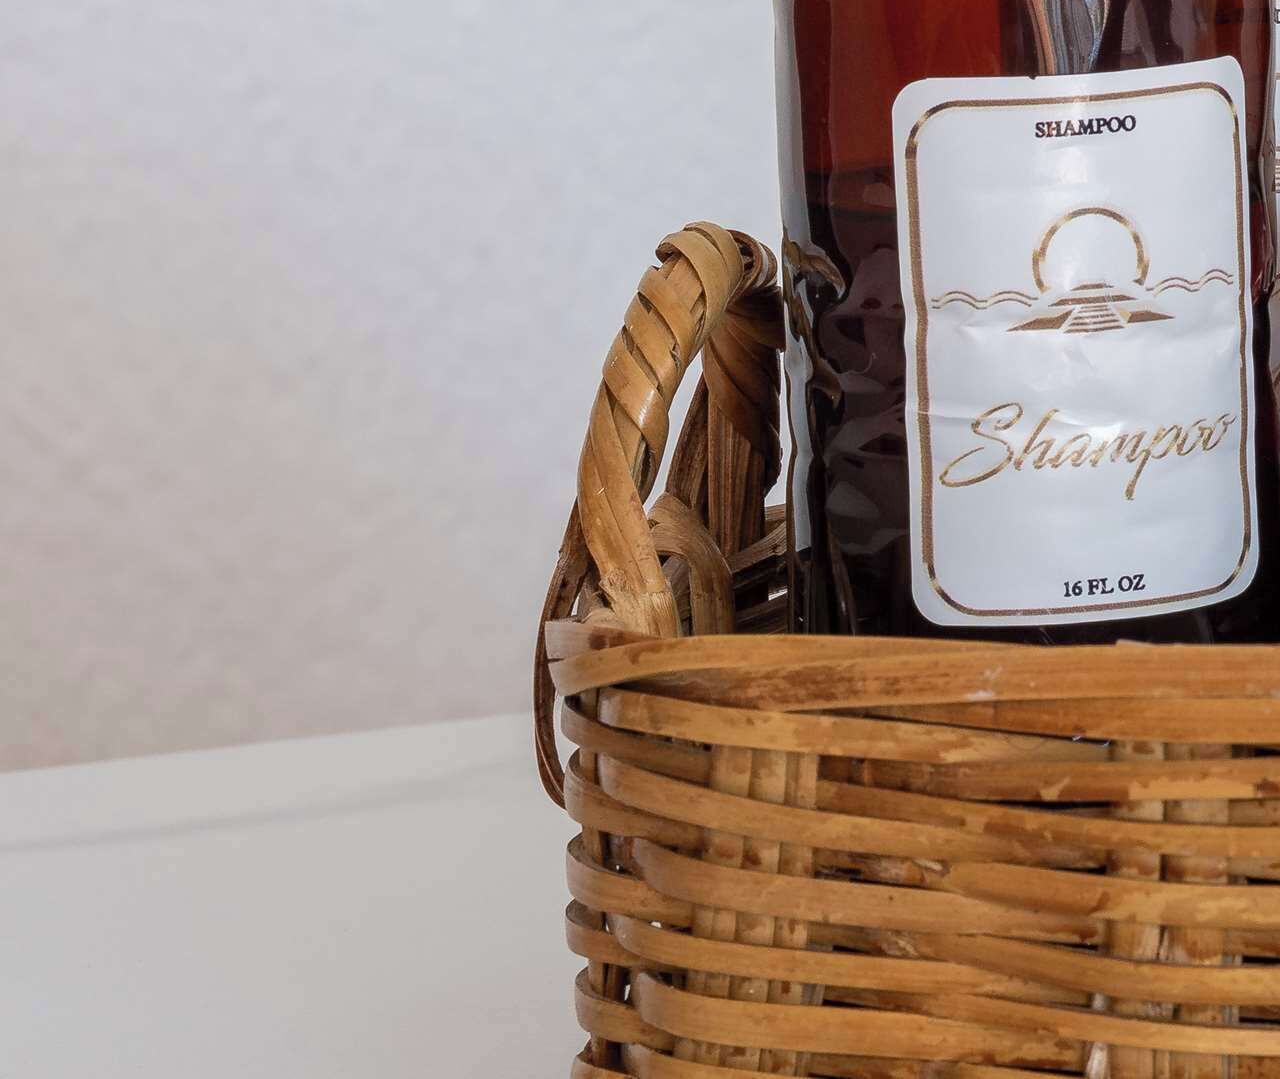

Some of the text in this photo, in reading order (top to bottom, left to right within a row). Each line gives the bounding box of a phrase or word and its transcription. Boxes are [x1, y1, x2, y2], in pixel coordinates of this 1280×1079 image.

[1034, 115, 1137, 139] SHAMPOO
[938, 401, 1238, 501] Shampoo
[1063, 573, 1146, 598] 16 FL OZ
